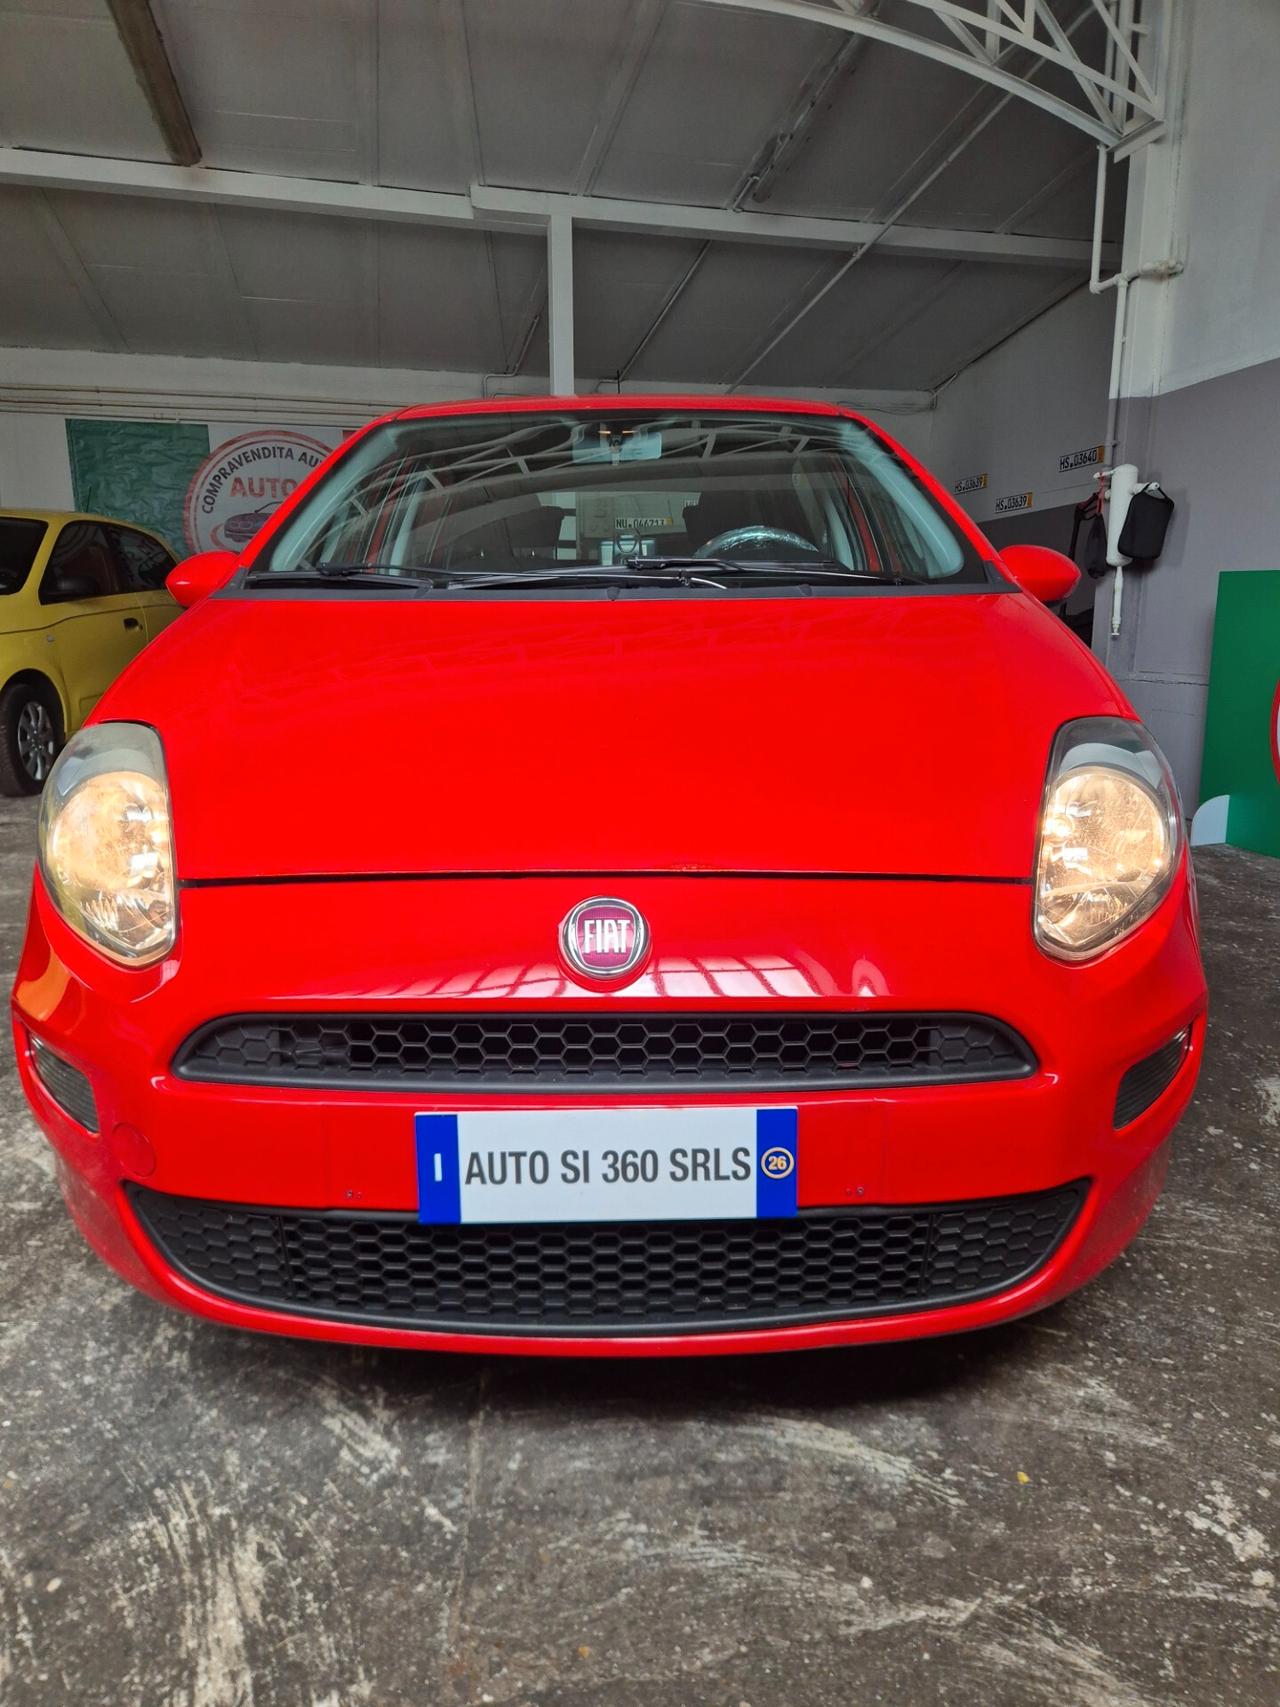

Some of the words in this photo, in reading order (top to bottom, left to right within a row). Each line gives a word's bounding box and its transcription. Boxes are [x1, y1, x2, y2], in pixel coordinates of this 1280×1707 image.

[202, 446, 294, 514] COMPRAVENDITA
[298, 451, 322, 468] AU
[584, 919, 631, 954] FIAT
[465, 1150, 550, 1185] AUTO
[560, 1149, 590, 1184] SI
[601, 1149, 659, 1183] 360
[669, 1147, 751, 1182] SRLS
[768, 1155, 788, 1171] 26
